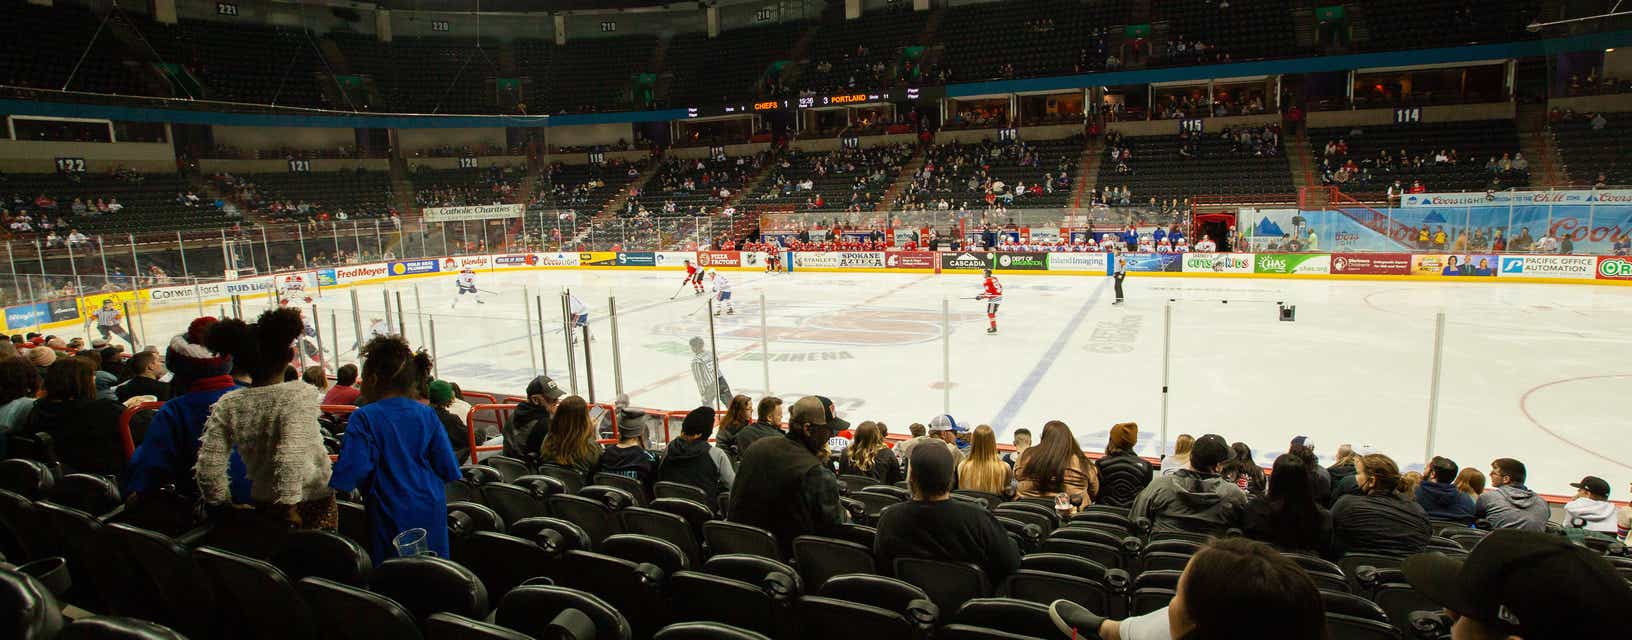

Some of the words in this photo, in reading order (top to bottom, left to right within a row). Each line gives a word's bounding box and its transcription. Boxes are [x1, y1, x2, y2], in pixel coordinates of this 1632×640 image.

[218, 4, 236, 14] 221
[823, 96, 829, 104] 3
[831, 94, 866, 104] PORTLAND
[755, 101, 778, 110] CHIEFS
[1397, 109, 1419, 122] 114
[1183, 120, 1201, 132] 115
[843, 137, 858, 147] 117
[57, 159, 86, 172] 122
[290, 161, 310, 172] 121
[1432, 196, 1459, 205] Coors
[1533, 193, 1562, 202] Chill
[1599, 192, 1632, 202] Coors
[440, 206, 473, 216] Catholic
[475, 203, 511, 214] Charities
[842, 252, 881, 260] SPOKANE
[840, 258, 882, 267] AZTECA
[1187, 258, 1213, 269] CUTS
[1225, 257, 1250, 269] KIDS
[1261, 258, 1287, 268] CHAS
[151, 288, 193, 300] Corwin
